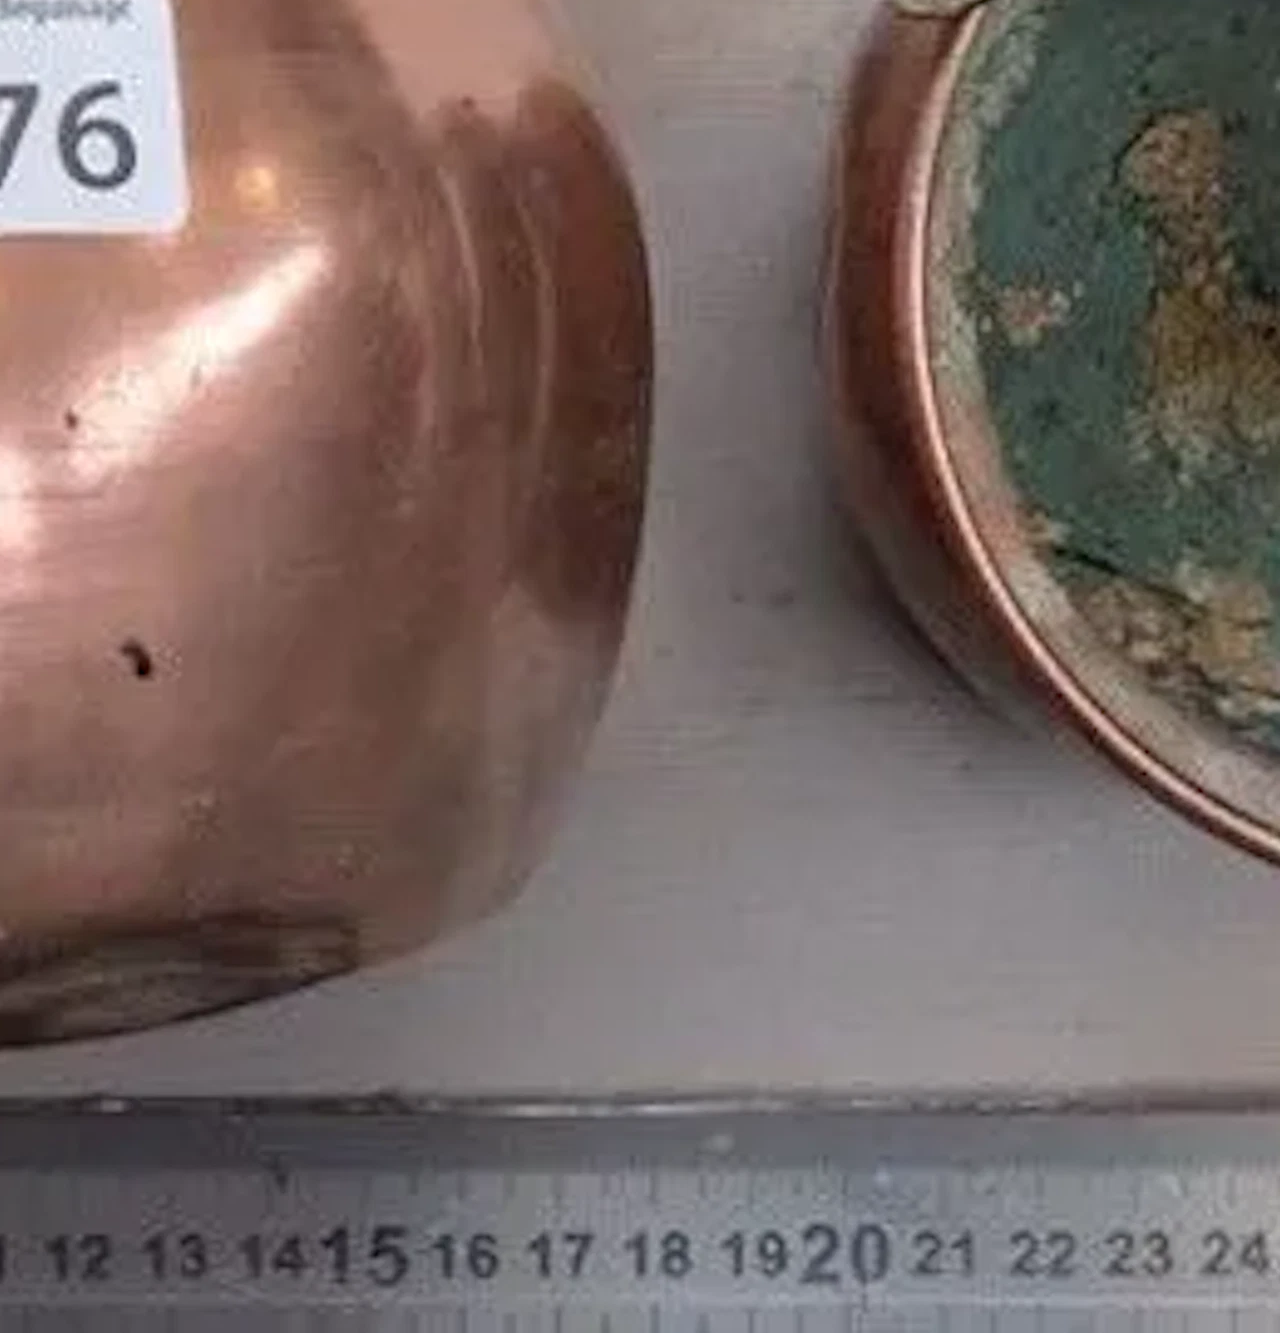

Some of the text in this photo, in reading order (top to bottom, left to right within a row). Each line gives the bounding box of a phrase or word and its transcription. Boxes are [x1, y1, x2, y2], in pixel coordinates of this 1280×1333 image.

[46, 1235, 111, 1281] 12
[142, 1233, 208, 1280] 13
[239, 1233, 307, 1279] 14
[322, 1225, 409, 1287] 15
[431, 1233, 500, 1280] 16
[527, 1231, 595, 1279] 17
[624, 1230, 694, 1280] 18
[720, 1230, 792, 1280] 19
[800, 1222, 892, 1287] 20
[912, 1229, 974, 1278] 21
[1009, 1229, 1077, 1279] 22
[1104, 1228, 1175, 1278] 23
[1200, 1228, 1270, 1278] 24
